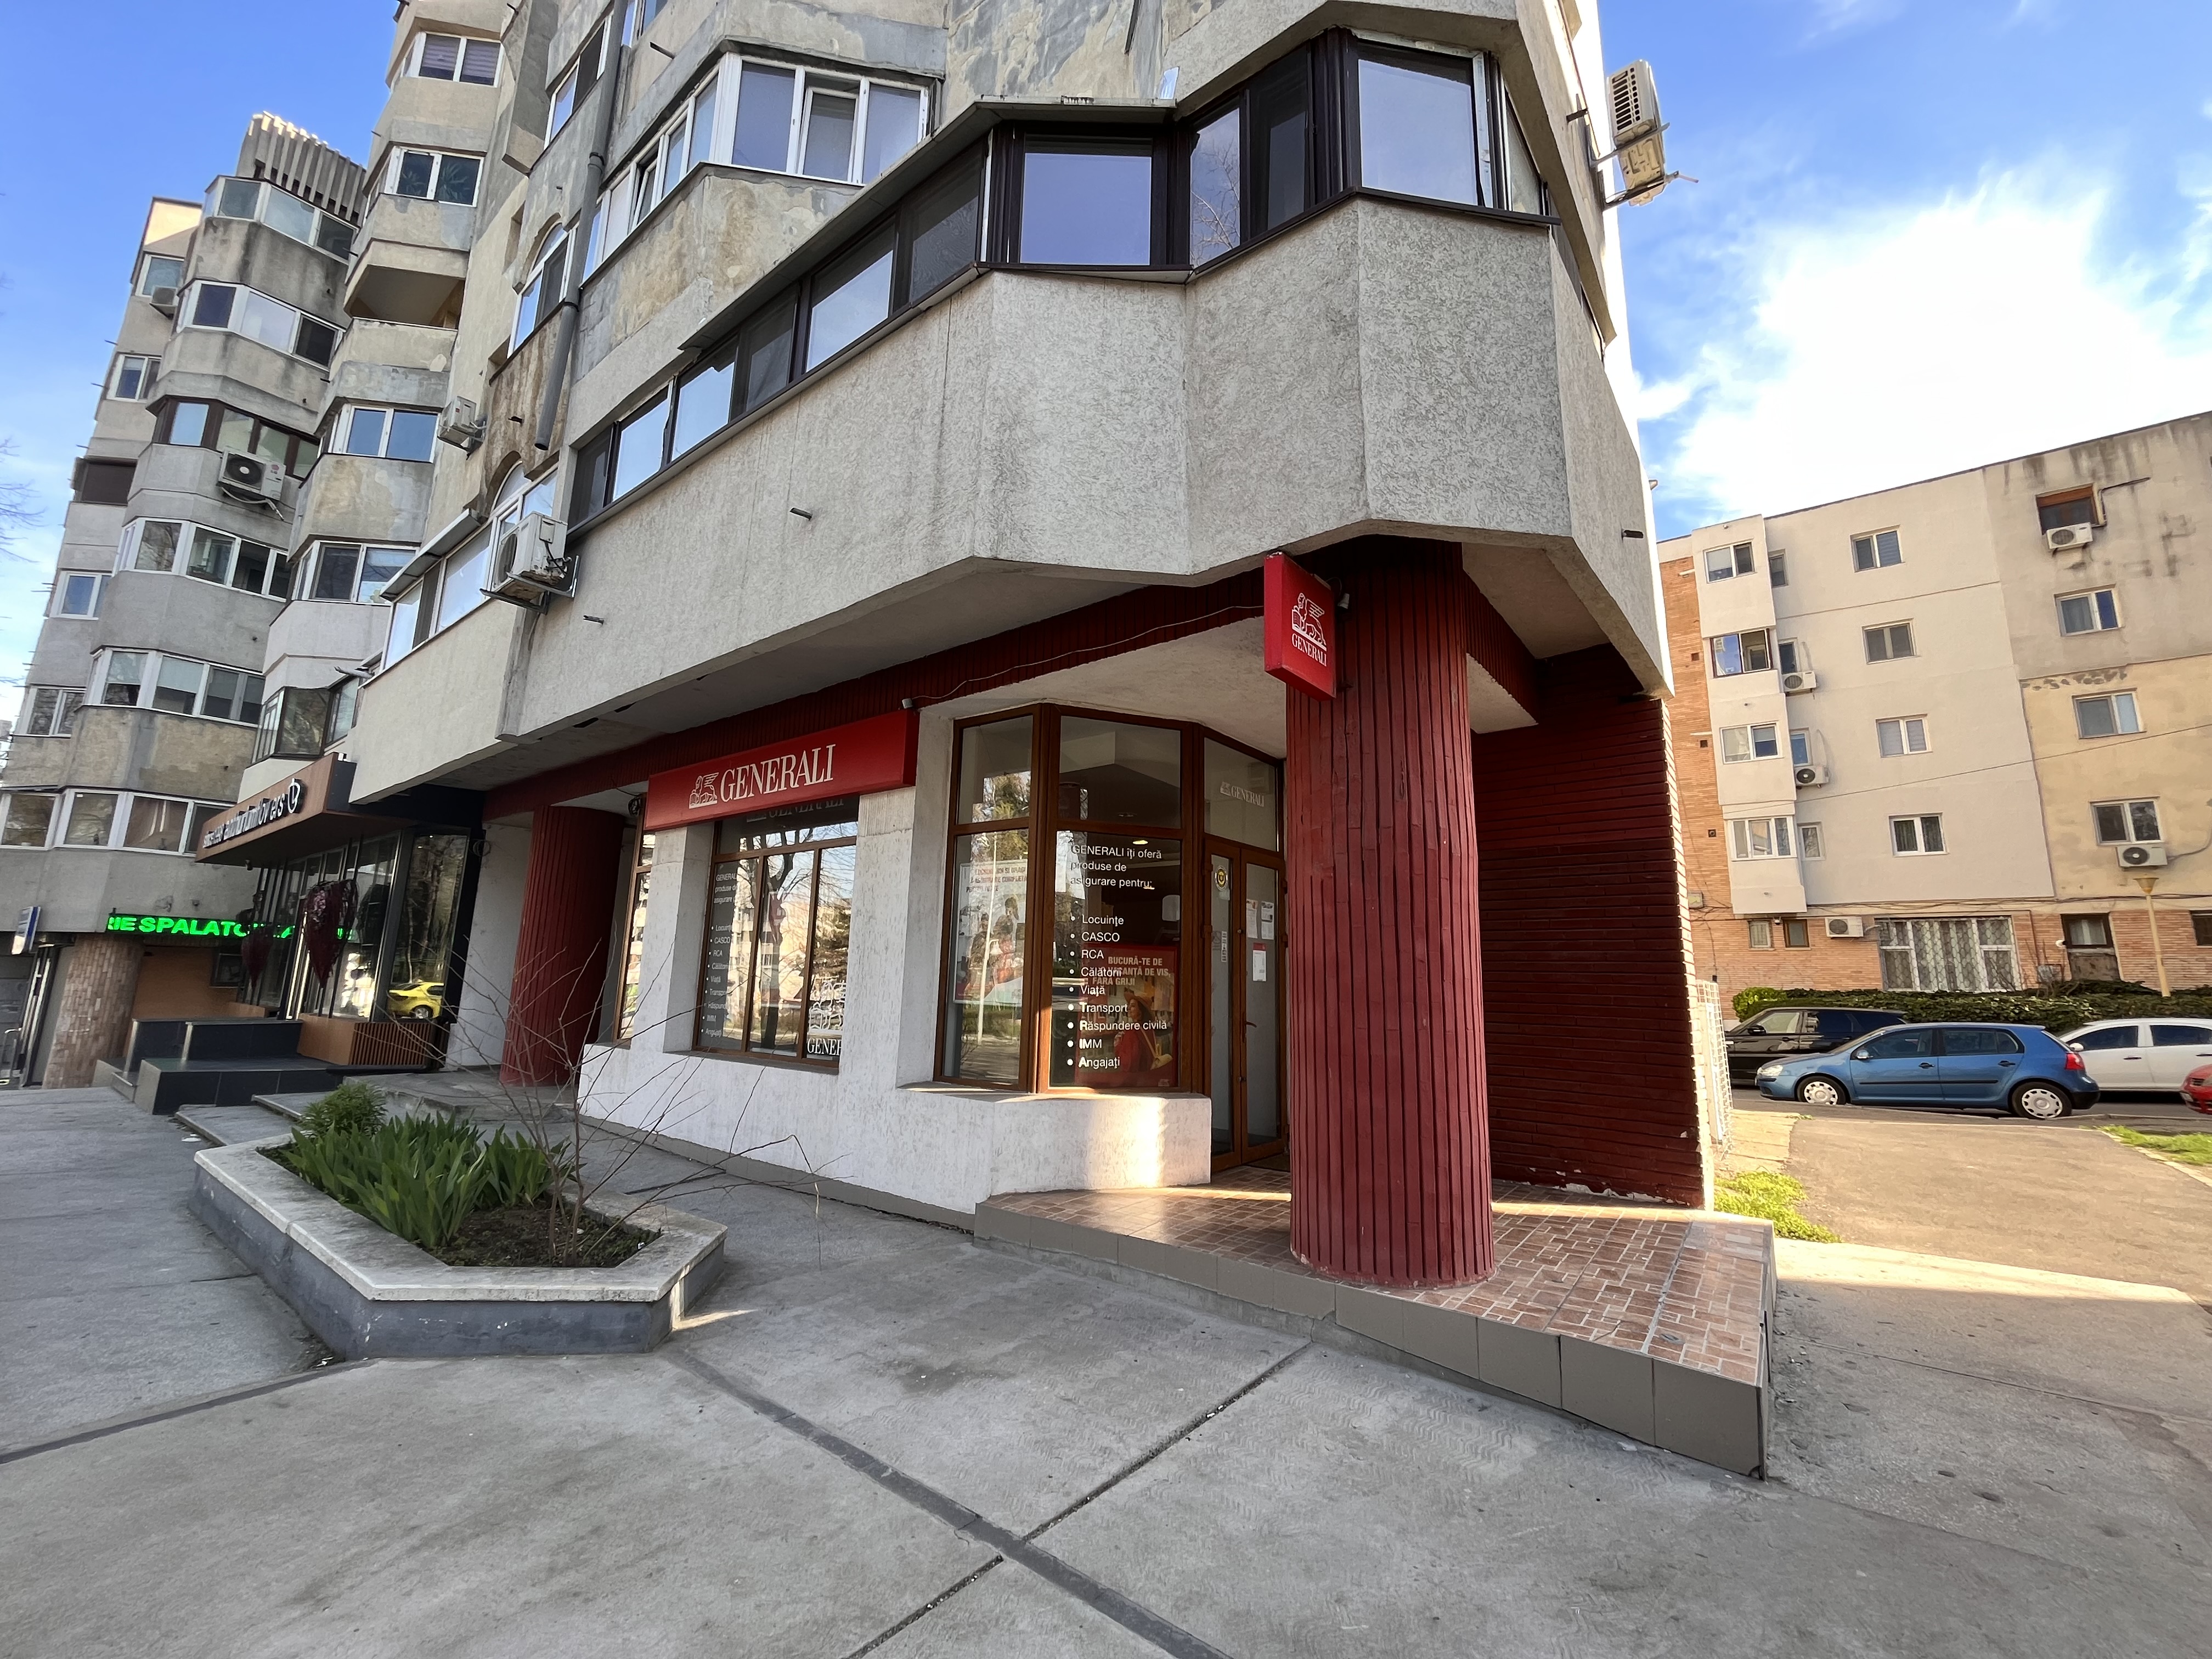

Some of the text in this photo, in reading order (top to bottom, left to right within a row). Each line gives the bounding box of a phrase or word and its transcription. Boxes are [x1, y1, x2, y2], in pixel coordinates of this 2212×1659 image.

[1292, 633, 1327, 667] GENERALI
[720, 743, 836, 803] GENERALI
[1231, 785, 1264, 807] GENERALI
[1071, 844, 1124, 856] GENERALI
[1138, 849, 1162, 859] oferă
[1071, 860, 1127, 871] produse de
[716, 873, 737, 882] GENERAL
[1070, 877, 1116, 887] asigurare
[1081, 932, 1120, 942] CASCO
[1081, 949, 1104, 959] RCA
[1108, 956, 1150, 966] BUCURĂ-TE
[1145, 968, 1155, 976] DE
[1115, 977, 1135, 985] GRIJI
[1079, 1001, 1128, 1013] Transport
[1079, 1020, 1167, 1032] Răspundere civilă
[1079, 1039, 1102, 1049] IMM
